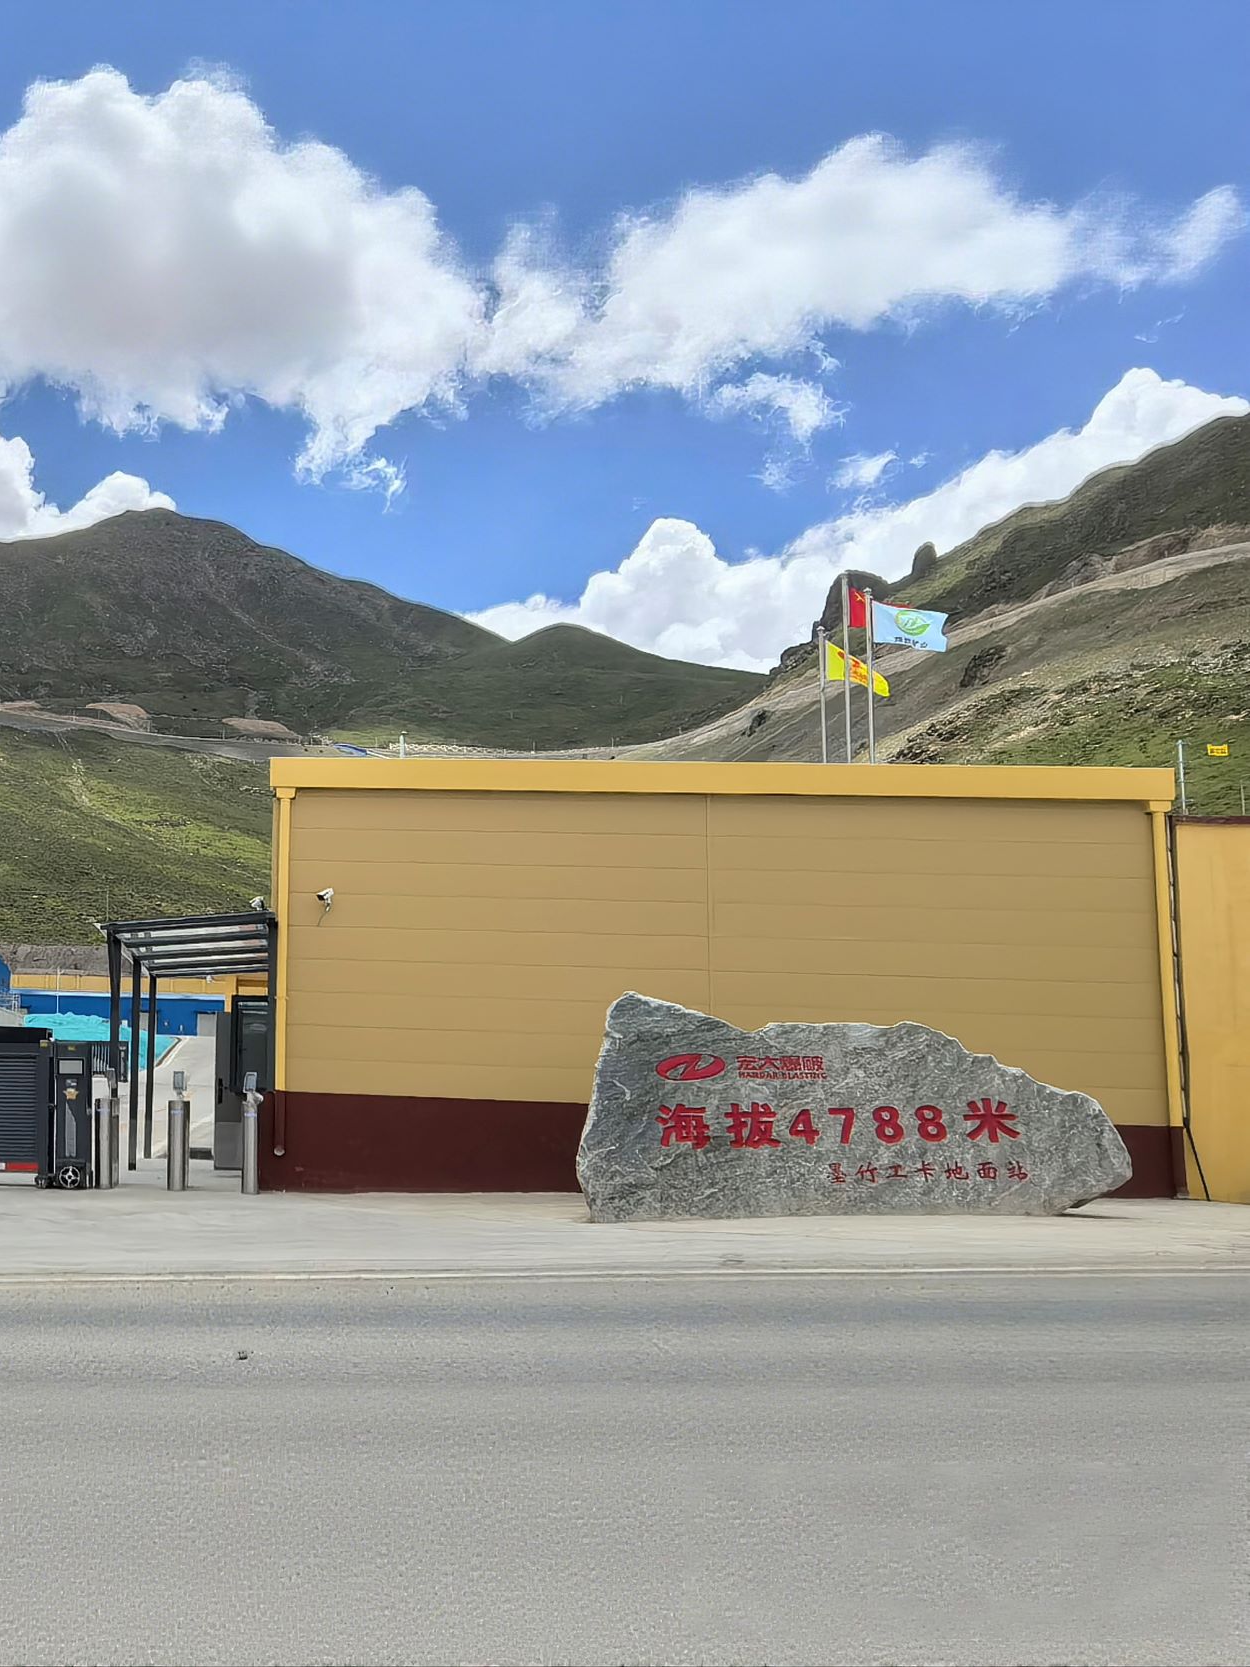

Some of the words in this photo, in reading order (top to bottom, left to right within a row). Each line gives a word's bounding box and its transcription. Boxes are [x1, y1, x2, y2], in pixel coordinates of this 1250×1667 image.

[736, 1055, 825, 1071] 宏大爆破
[655, 1098, 1022, 1150] 海拔4788米
[827, 1160, 1029, 1184] 墨竹工卡地面站
